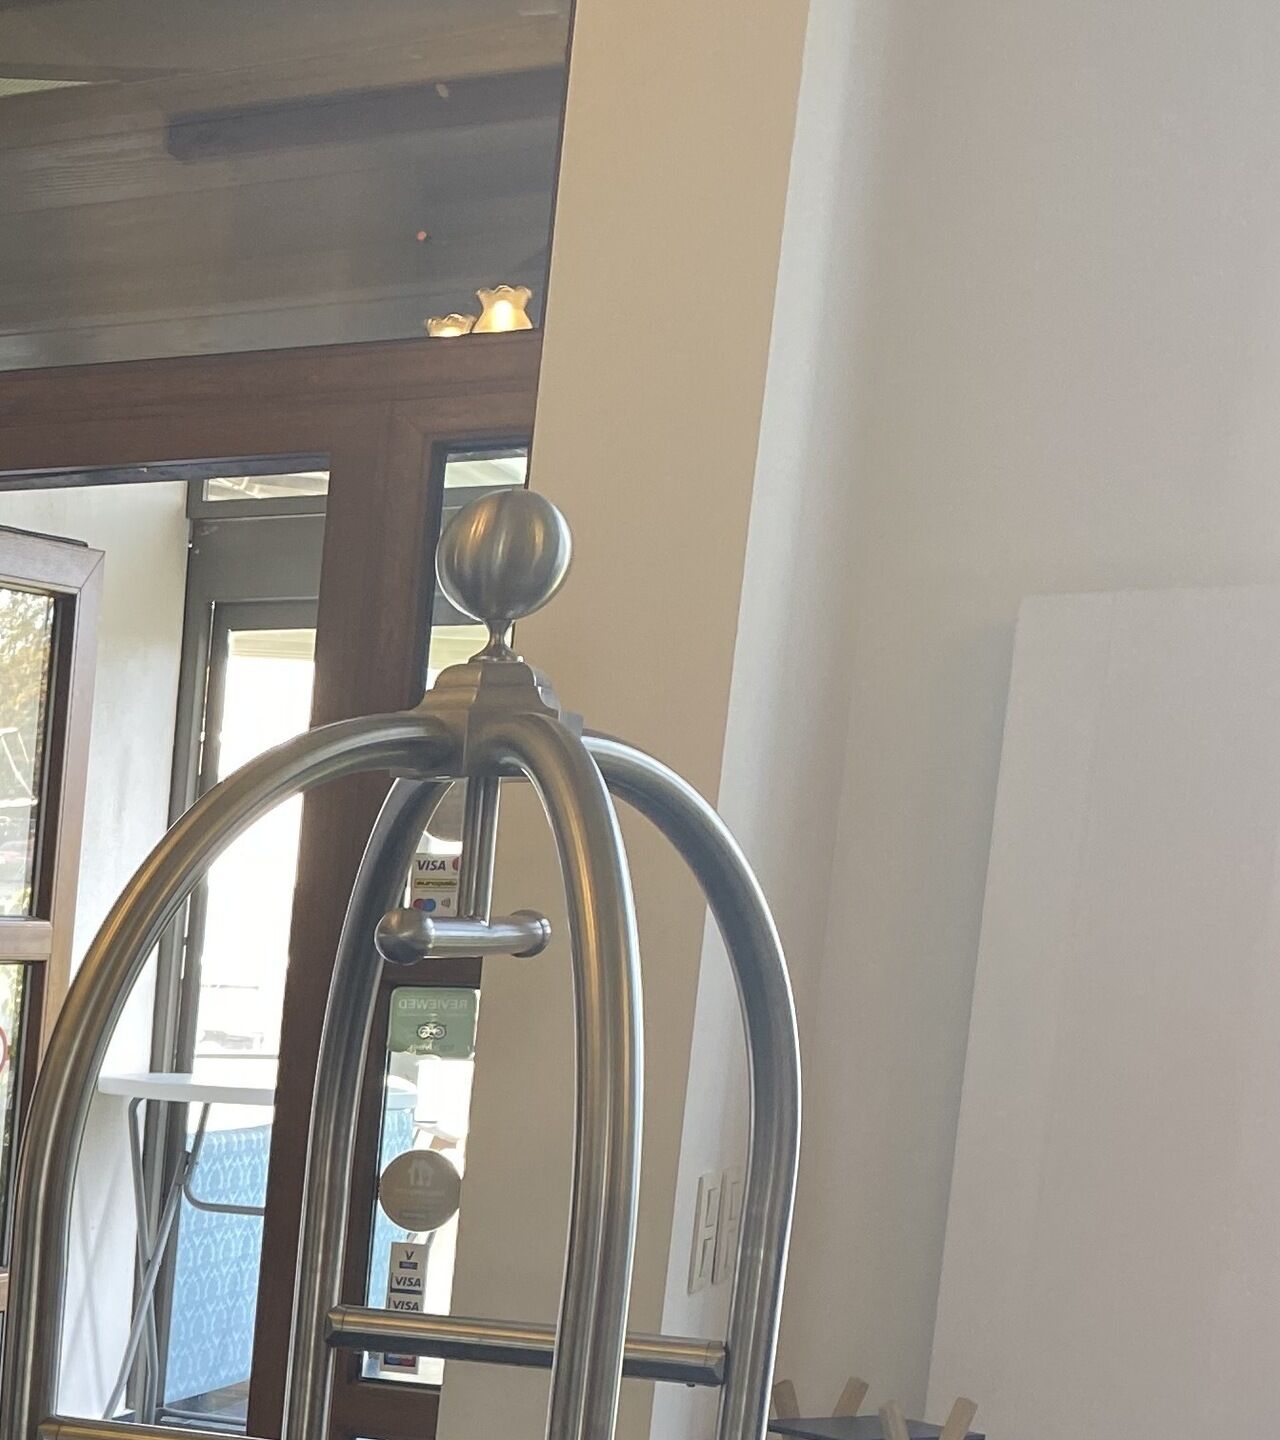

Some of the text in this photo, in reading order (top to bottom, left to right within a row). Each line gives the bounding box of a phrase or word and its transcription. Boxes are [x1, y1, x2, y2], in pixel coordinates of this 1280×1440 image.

[417, 860, 446, 871] VISA
[395, 1276, 422, 1288] VISA
[392, 1300, 420, 1311] VISA
